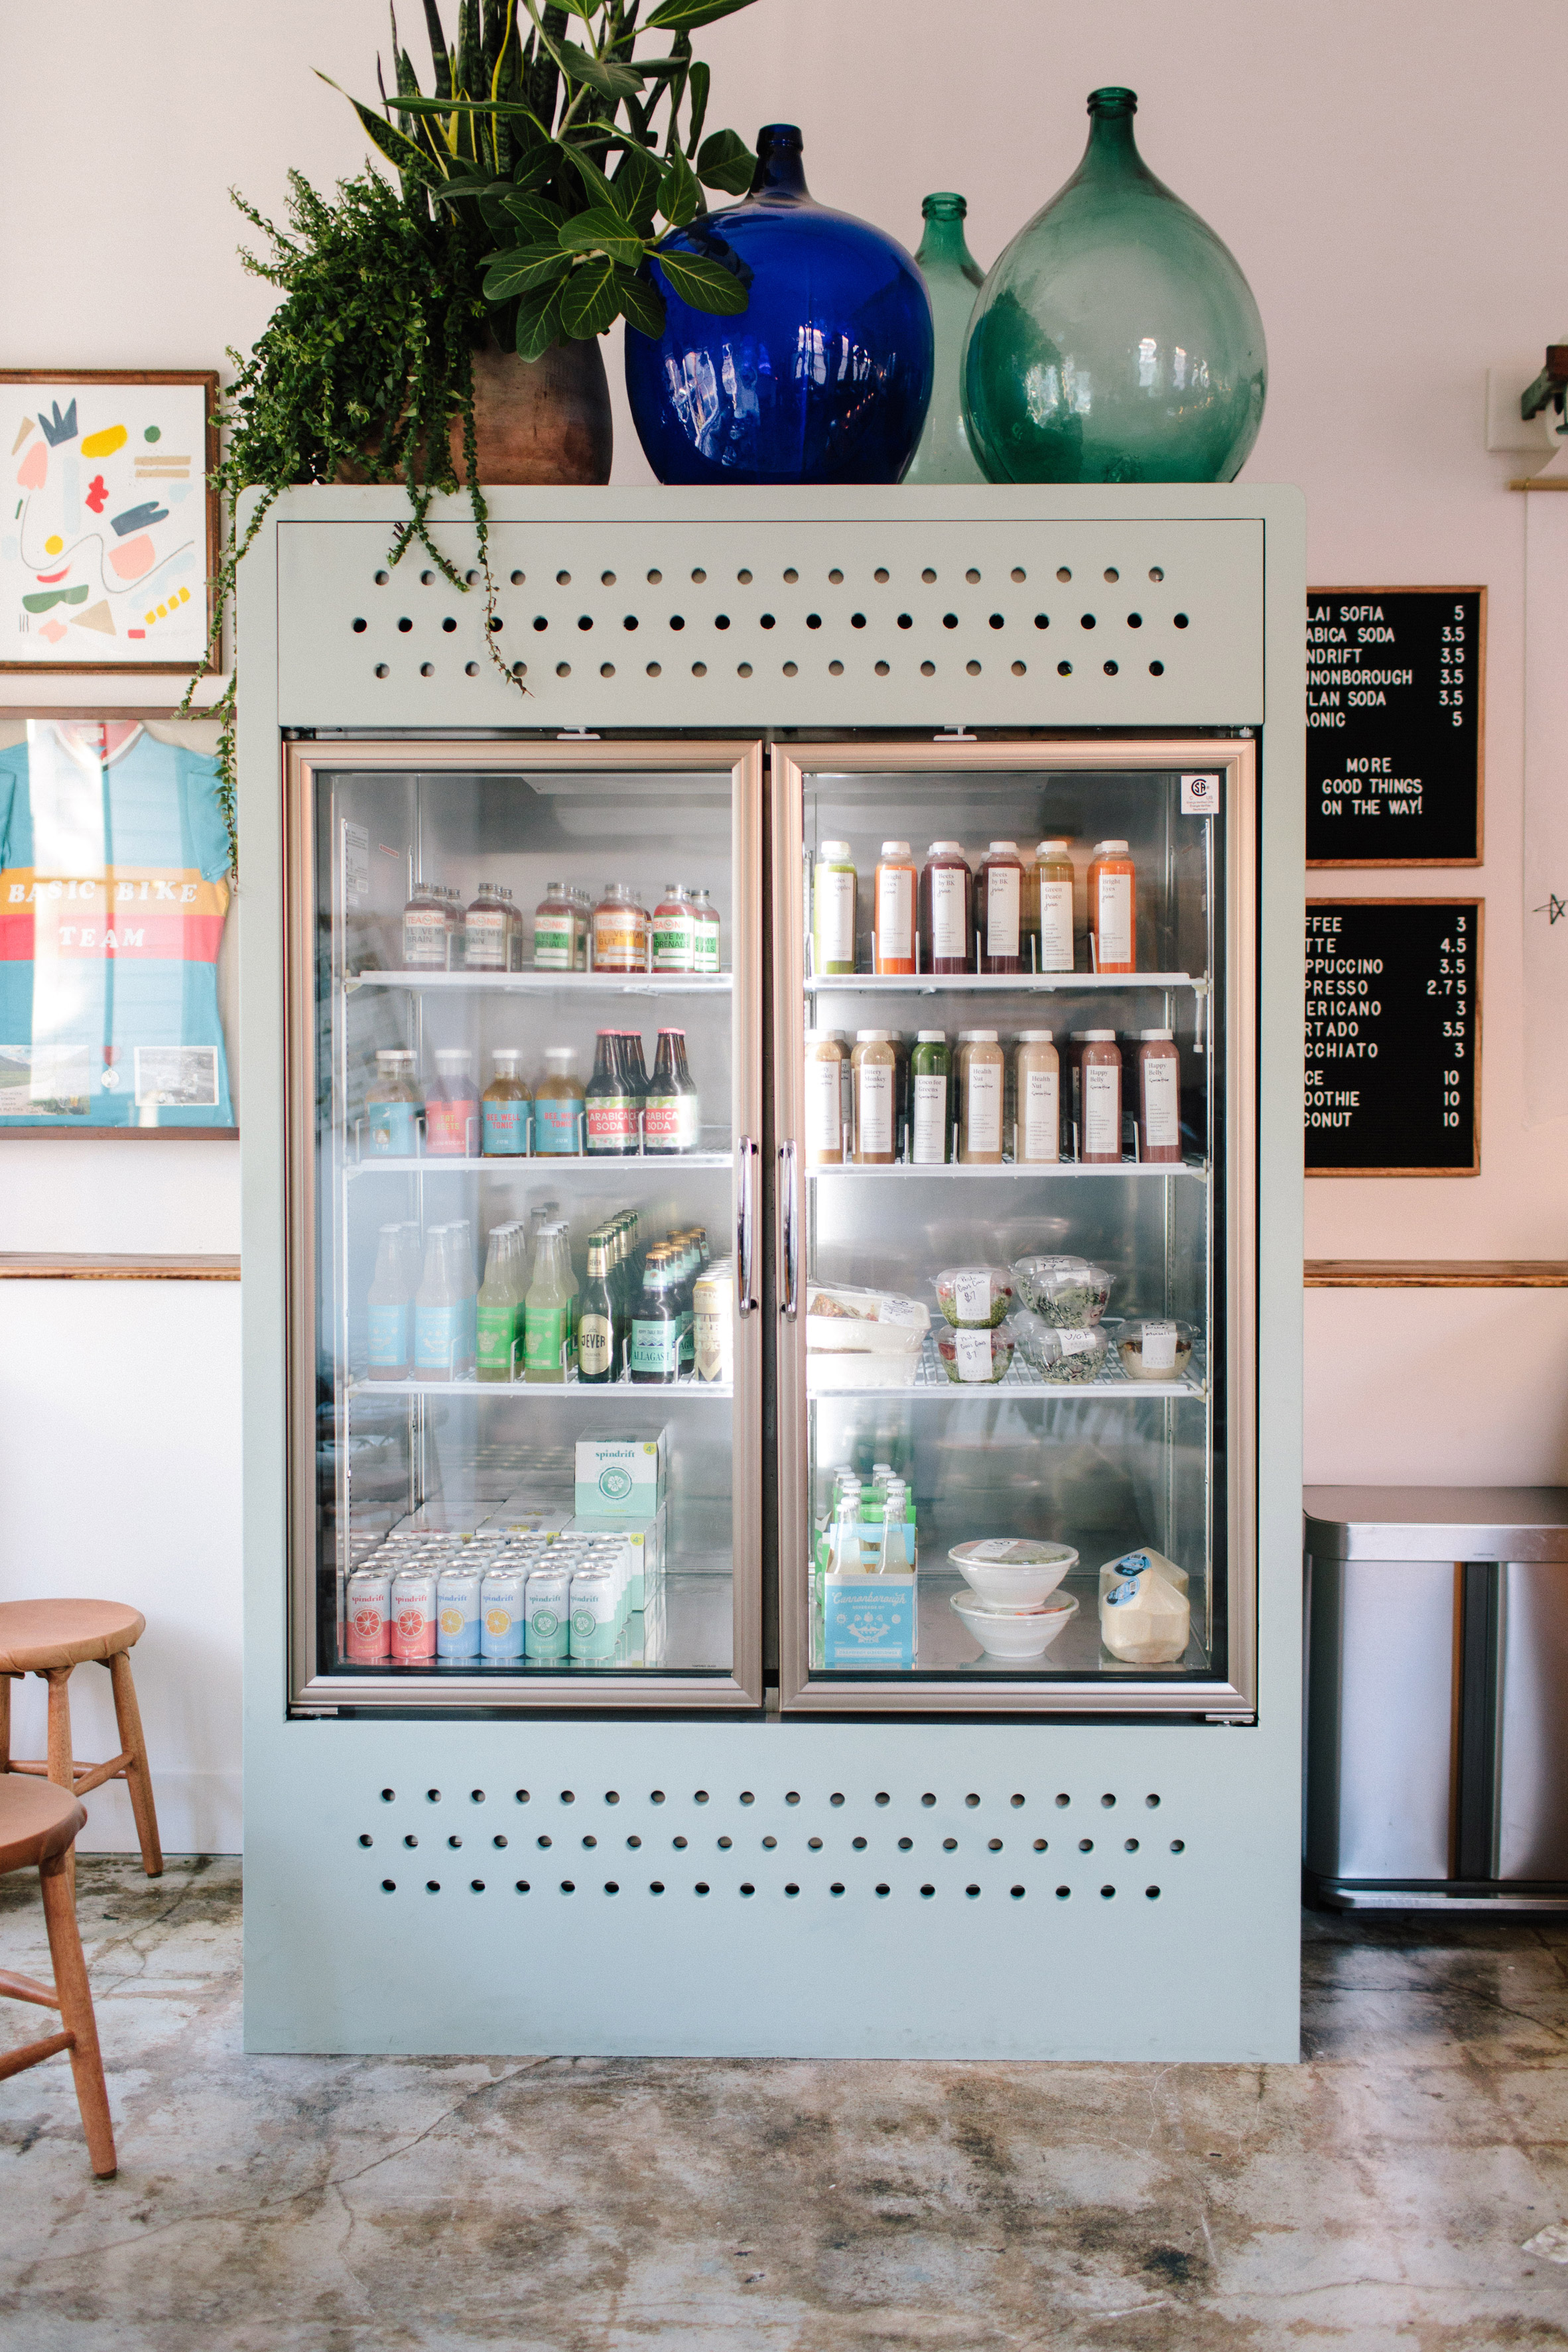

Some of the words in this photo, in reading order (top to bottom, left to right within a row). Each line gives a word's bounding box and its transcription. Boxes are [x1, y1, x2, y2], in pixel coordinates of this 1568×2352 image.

[1340, 606, 1384, 621] SOFIA
[1454, 605, 1465, 621] 5
[1307, 627, 1346, 643] ABICA
[1357, 627, 1395, 643] SODA
[1441, 626, 1465, 642] 3.5
[1307, 648, 1362, 664] NDRIFT
[1440, 647, 1465, 665] 3.5
[1439, 669, 1464, 685] 3.5
[1347, 690, 1386, 706] SODA
[1438, 690, 1464, 706] 3.5
[1451, 711, 1463, 727] 5
[1346, 757, 1392, 773] MORE
[1321, 779, 1362, 795] GOOD
[1369, 778, 1423, 795] THINGS
[1321, 800, 1342, 815] ON
[1352, 799, 1381, 815] THE
[1388, 796, 1423, 815] WAY!
[8, 880, 96, 903] BASIC
[115, 881, 198, 903] BIKE
[1457, 917, 1466, 932] 3
[58, 926, 146, 948] TEAM
[1305, 938, 1336, 953] TTE
[1439, 938, 1467, 953] 4.5
[1305, 959, 1384, 974] PPUCCINO
[1439, 959, 1466, 974] 3.5
[1426, 980, 1467, 996] 2.75
[1307, 1001, 1382, 1016] ERICANO
[1457, 1000, 1466, 1016] 3
[1442, 1021, 1465, 1037] 3.5
[1305, 1043, 1378, 1059] CCHIATO
[1455, 1043, 1465, 1058] 3
[1305, 1071, 1324, 1085] CE
[1443, 1071, 1459, 1085] 10
[1305, 1091, 1360, 1107] OOTHIE
[1443, 1091, 1460, 1106] 10
[589, 1112, 629, 1121] ARABICA
[1443, 1112, 1459, 1128] 10
[596, 1122, 623, 1131] SODA
[647, 1122, 671, 1130] SODA
[581, 1334, 605, 1348] JEVER
[596, 1449, 635, 1461] spindrift
[352, 1595, 384, 1604] spindrift
[395, 1595, 427, 1604] spindrift
[529, 1595, 561, 1604] spindrift
[832, 1592, 906, 1606] Cannonborough
